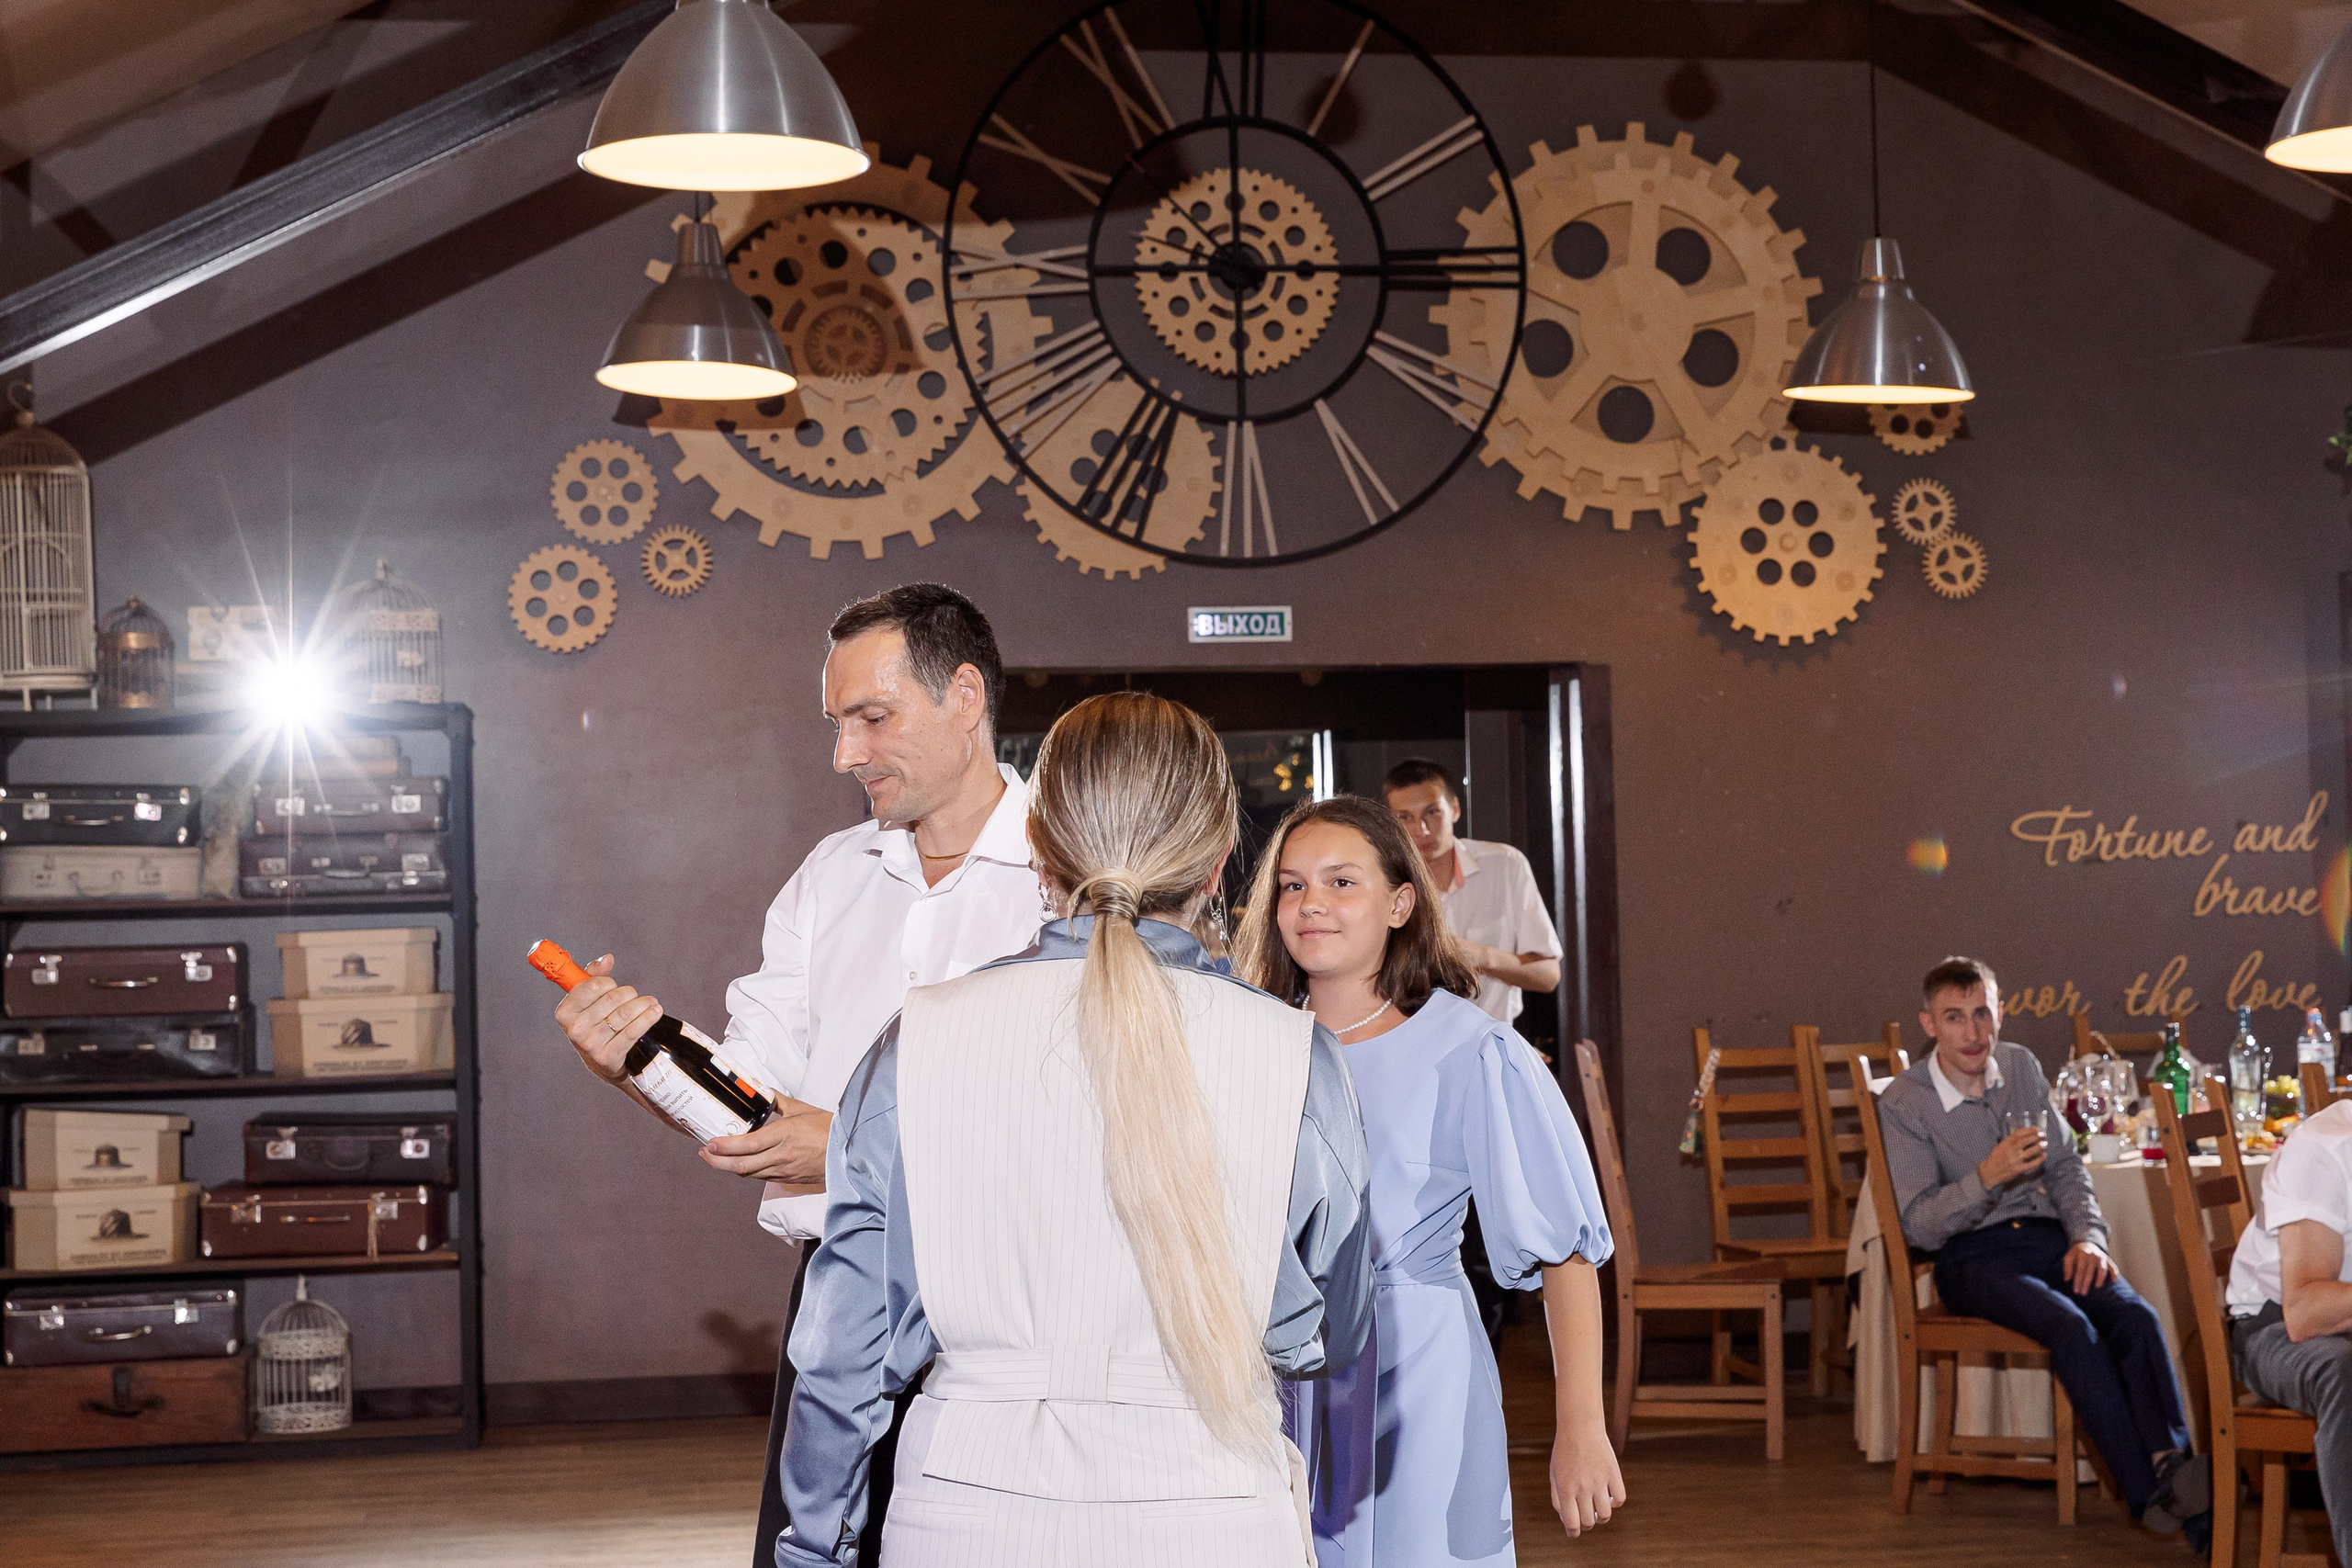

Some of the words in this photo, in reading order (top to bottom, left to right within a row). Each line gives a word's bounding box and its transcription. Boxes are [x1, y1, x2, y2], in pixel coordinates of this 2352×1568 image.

[1197, 614, 1282, 637] ВЫХОД
[2010, 805, 2215, 866] Fortune
[2233, 790, 2330, 852] and
[2193, 853, 2323, 918] brave
[2122, 954, 2199, 1018] the
[2226, 950, 2323, 1011] love
